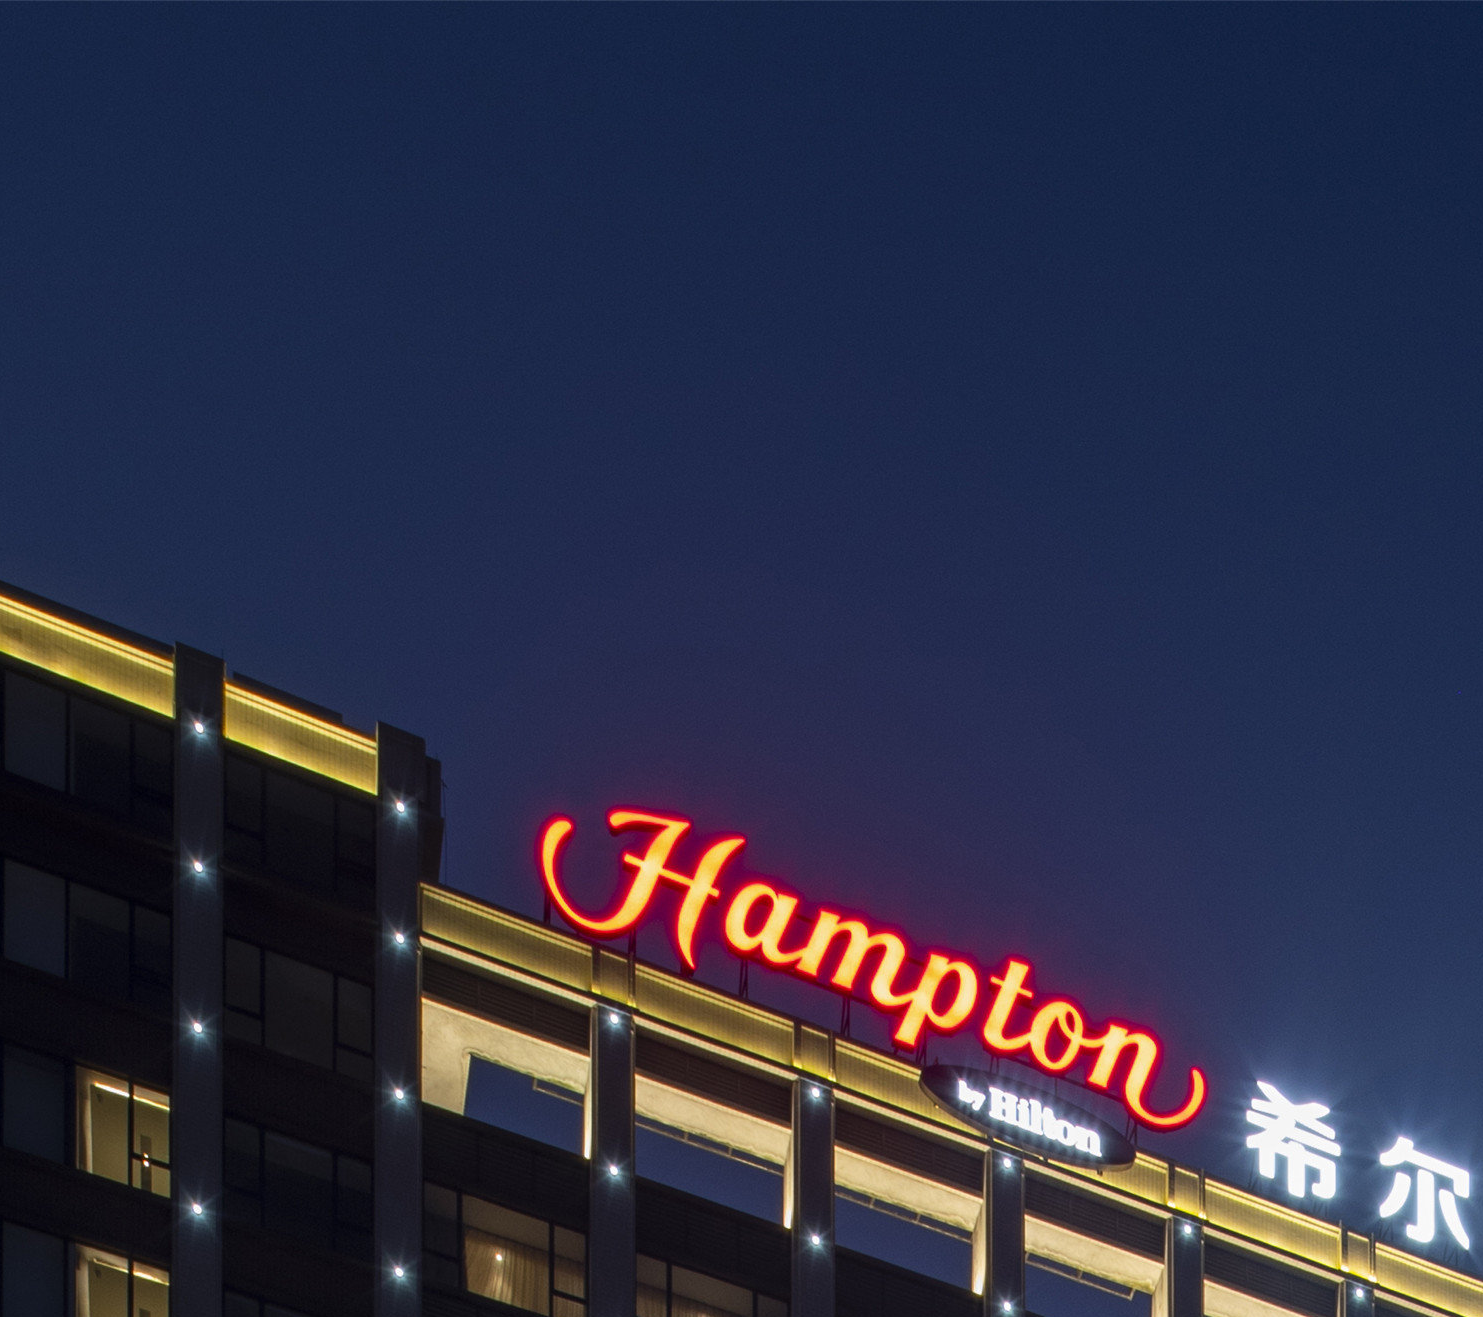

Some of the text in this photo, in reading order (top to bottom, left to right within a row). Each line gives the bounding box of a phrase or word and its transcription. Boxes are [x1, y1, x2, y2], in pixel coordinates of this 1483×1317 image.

[536, 808, 1206, 1130] Hampton
[958, 1079, 1102, 1157] by Hilton
